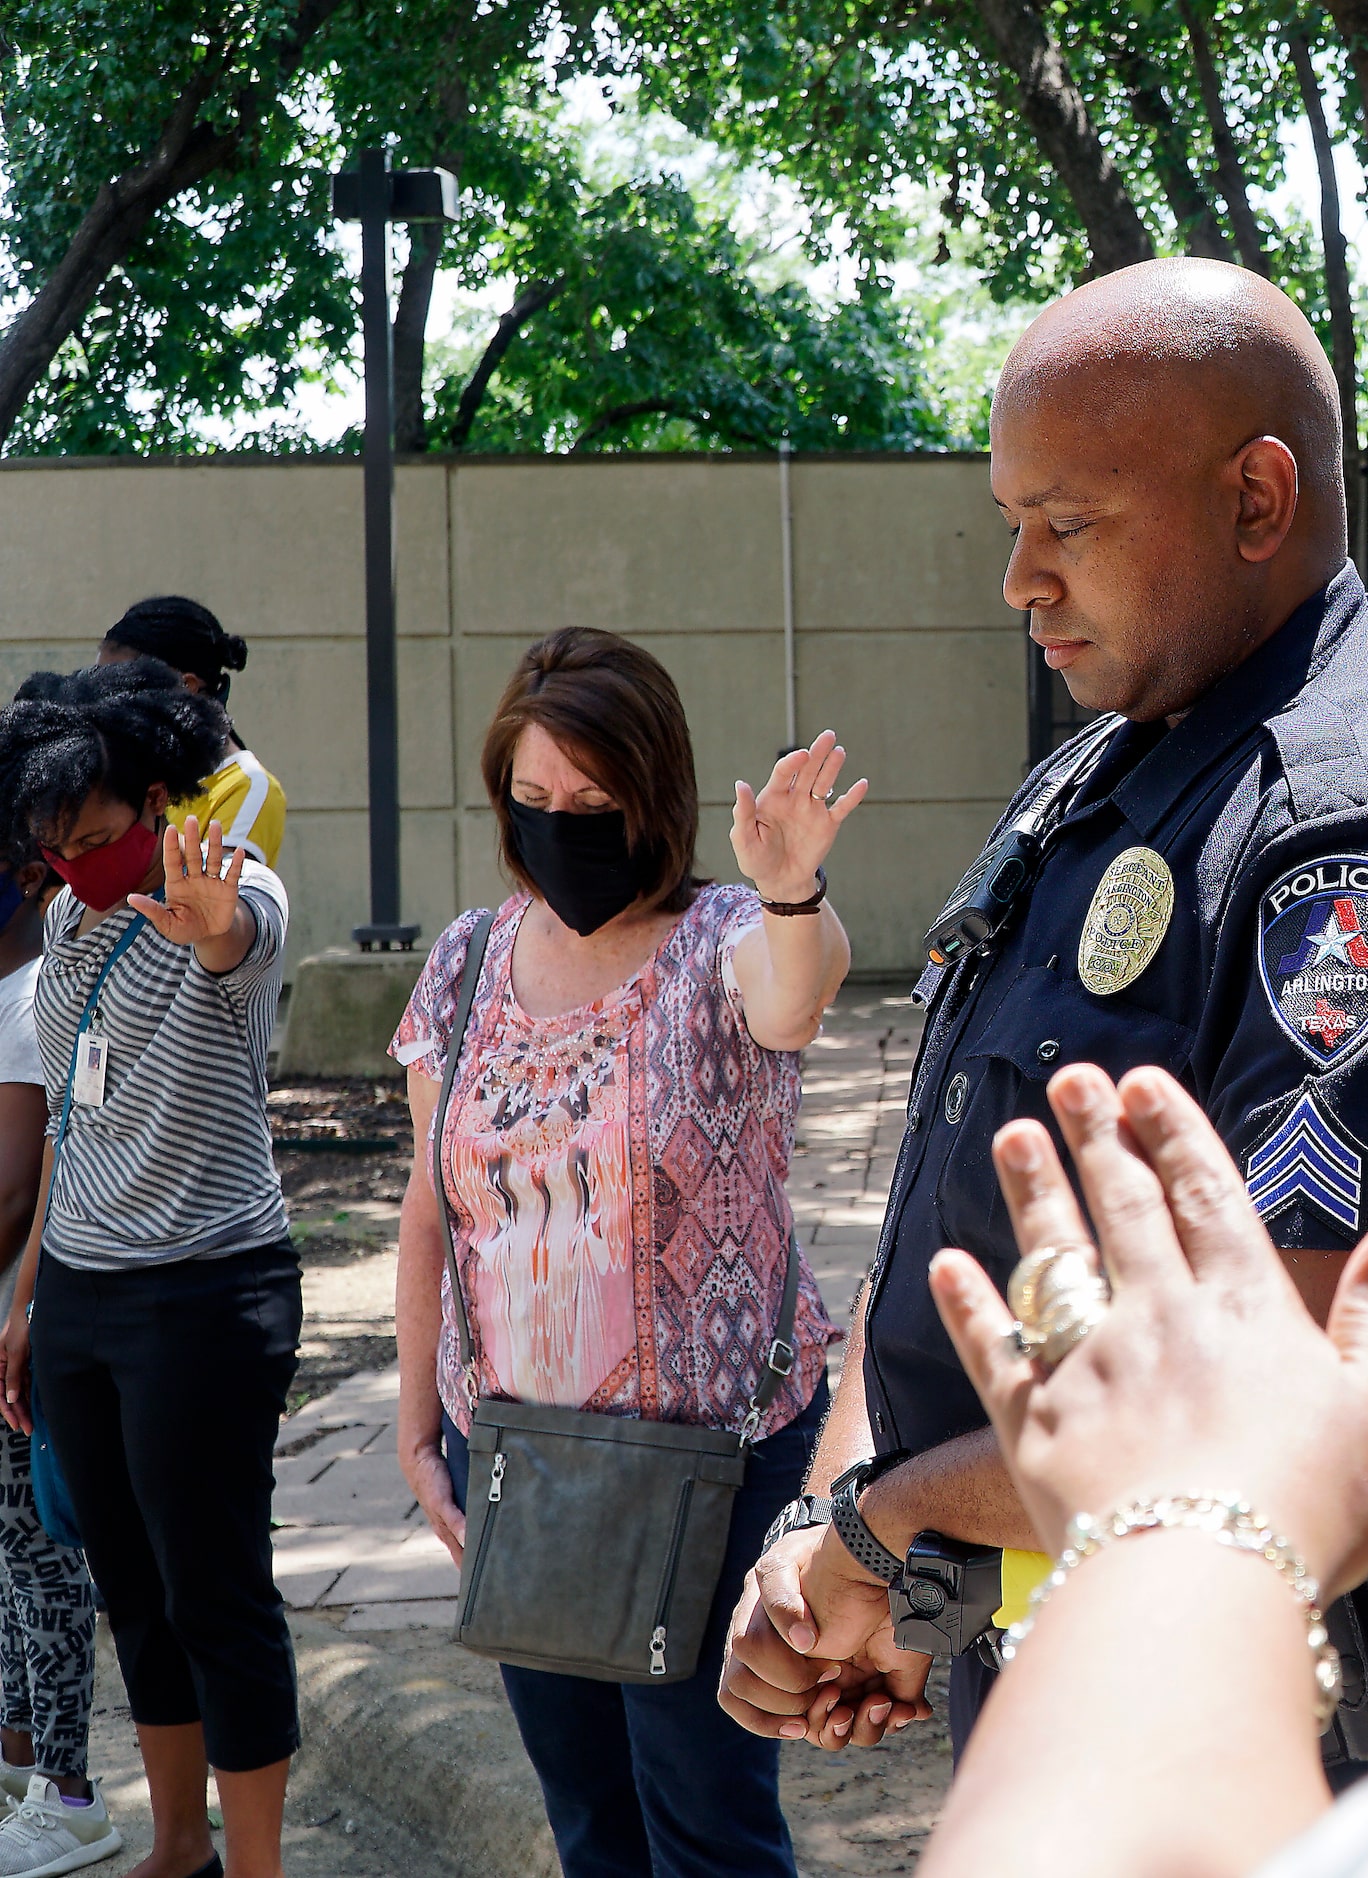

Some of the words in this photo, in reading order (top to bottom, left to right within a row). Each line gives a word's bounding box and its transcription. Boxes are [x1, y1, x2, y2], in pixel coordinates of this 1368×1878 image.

[1108, 862, 1167, 891] SERGEANT
[1104, 882, 1154, 907] ARLINGTON
[1088, 926, 1143, 950] POLICE
[1299, 1014, 1359, 1032] TEXAS
[28, 1546, 70, 1604] LOVE
[54, 1678, 82, 1741] LOVE
